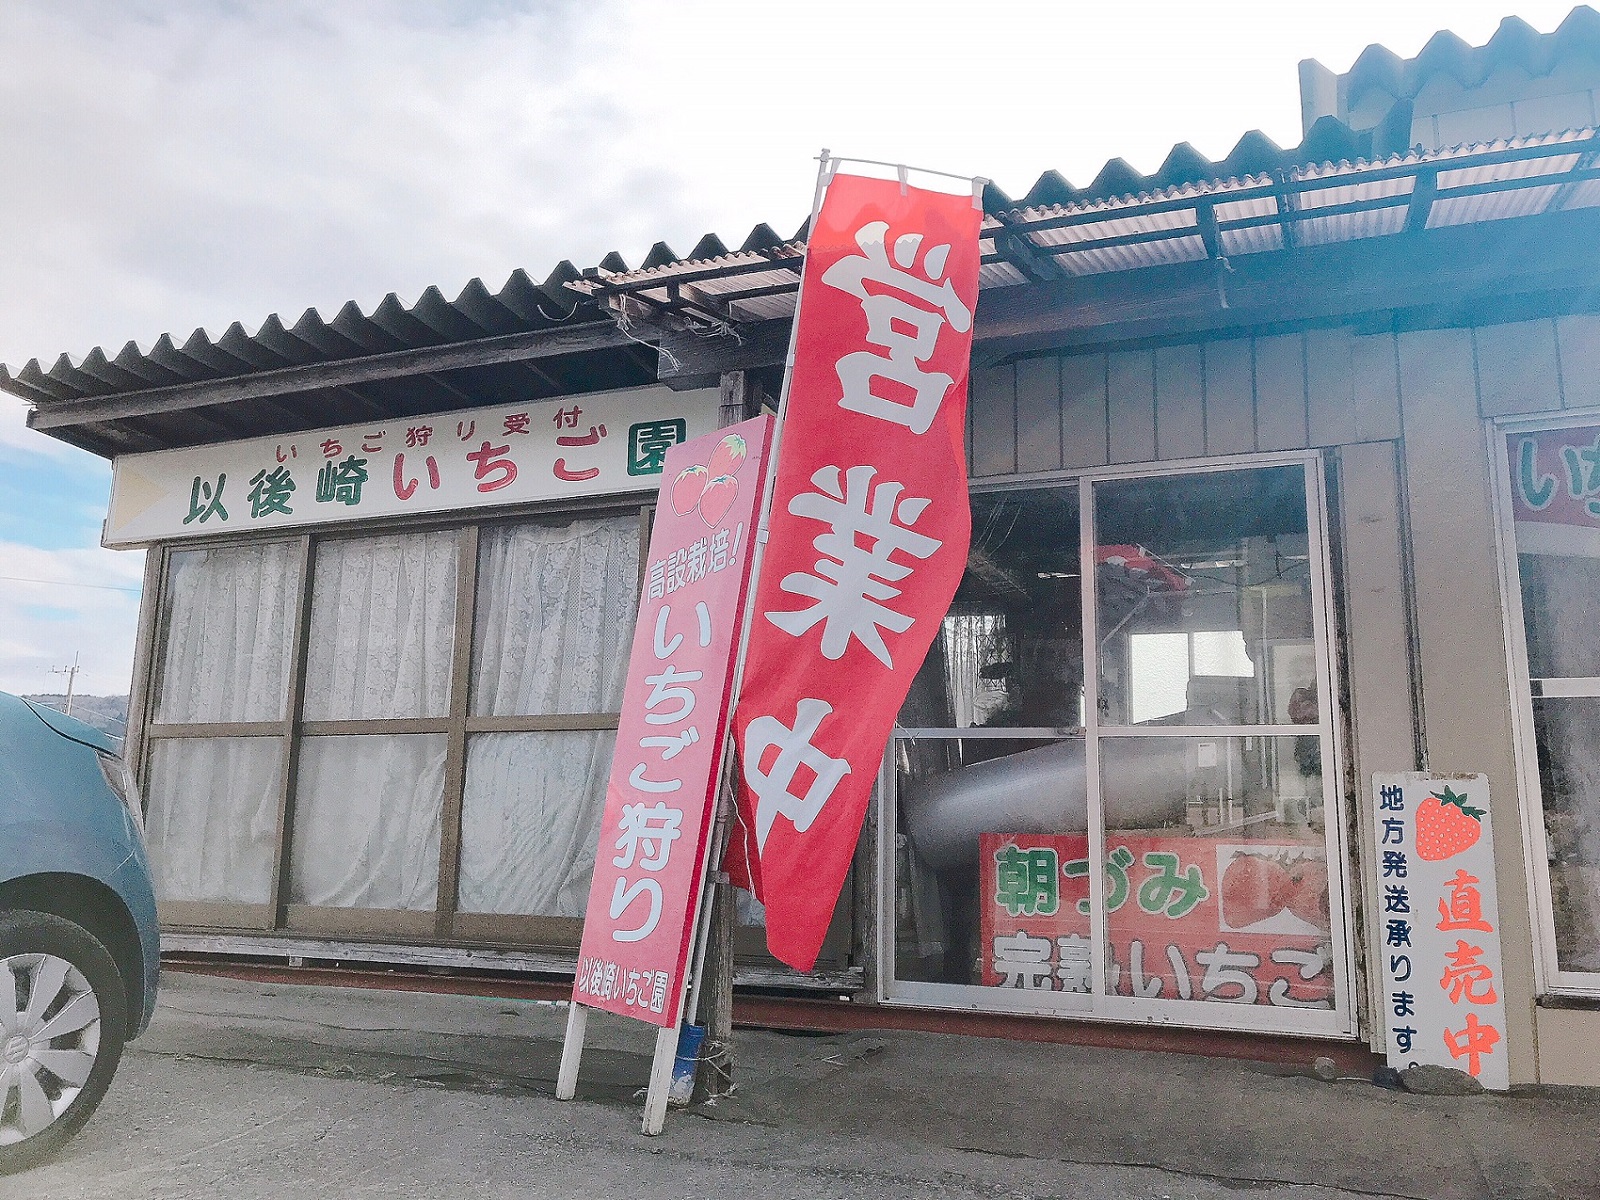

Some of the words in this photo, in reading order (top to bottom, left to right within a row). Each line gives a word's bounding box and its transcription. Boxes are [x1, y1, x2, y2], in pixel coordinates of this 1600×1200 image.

[183, 417, 686, 526] 以後崎いちご園
[276, 405, 583, 463] いちご狩り受付
[743, 221, 972, 854] 営業中
[609, 601, 713, 943] いちご狩り
[994, 845, 1210, 919] 朝づみ
[578, 955, 669, 1014] 以後崎いちご園
[1435, 869, 1500, 1077] 直売中
